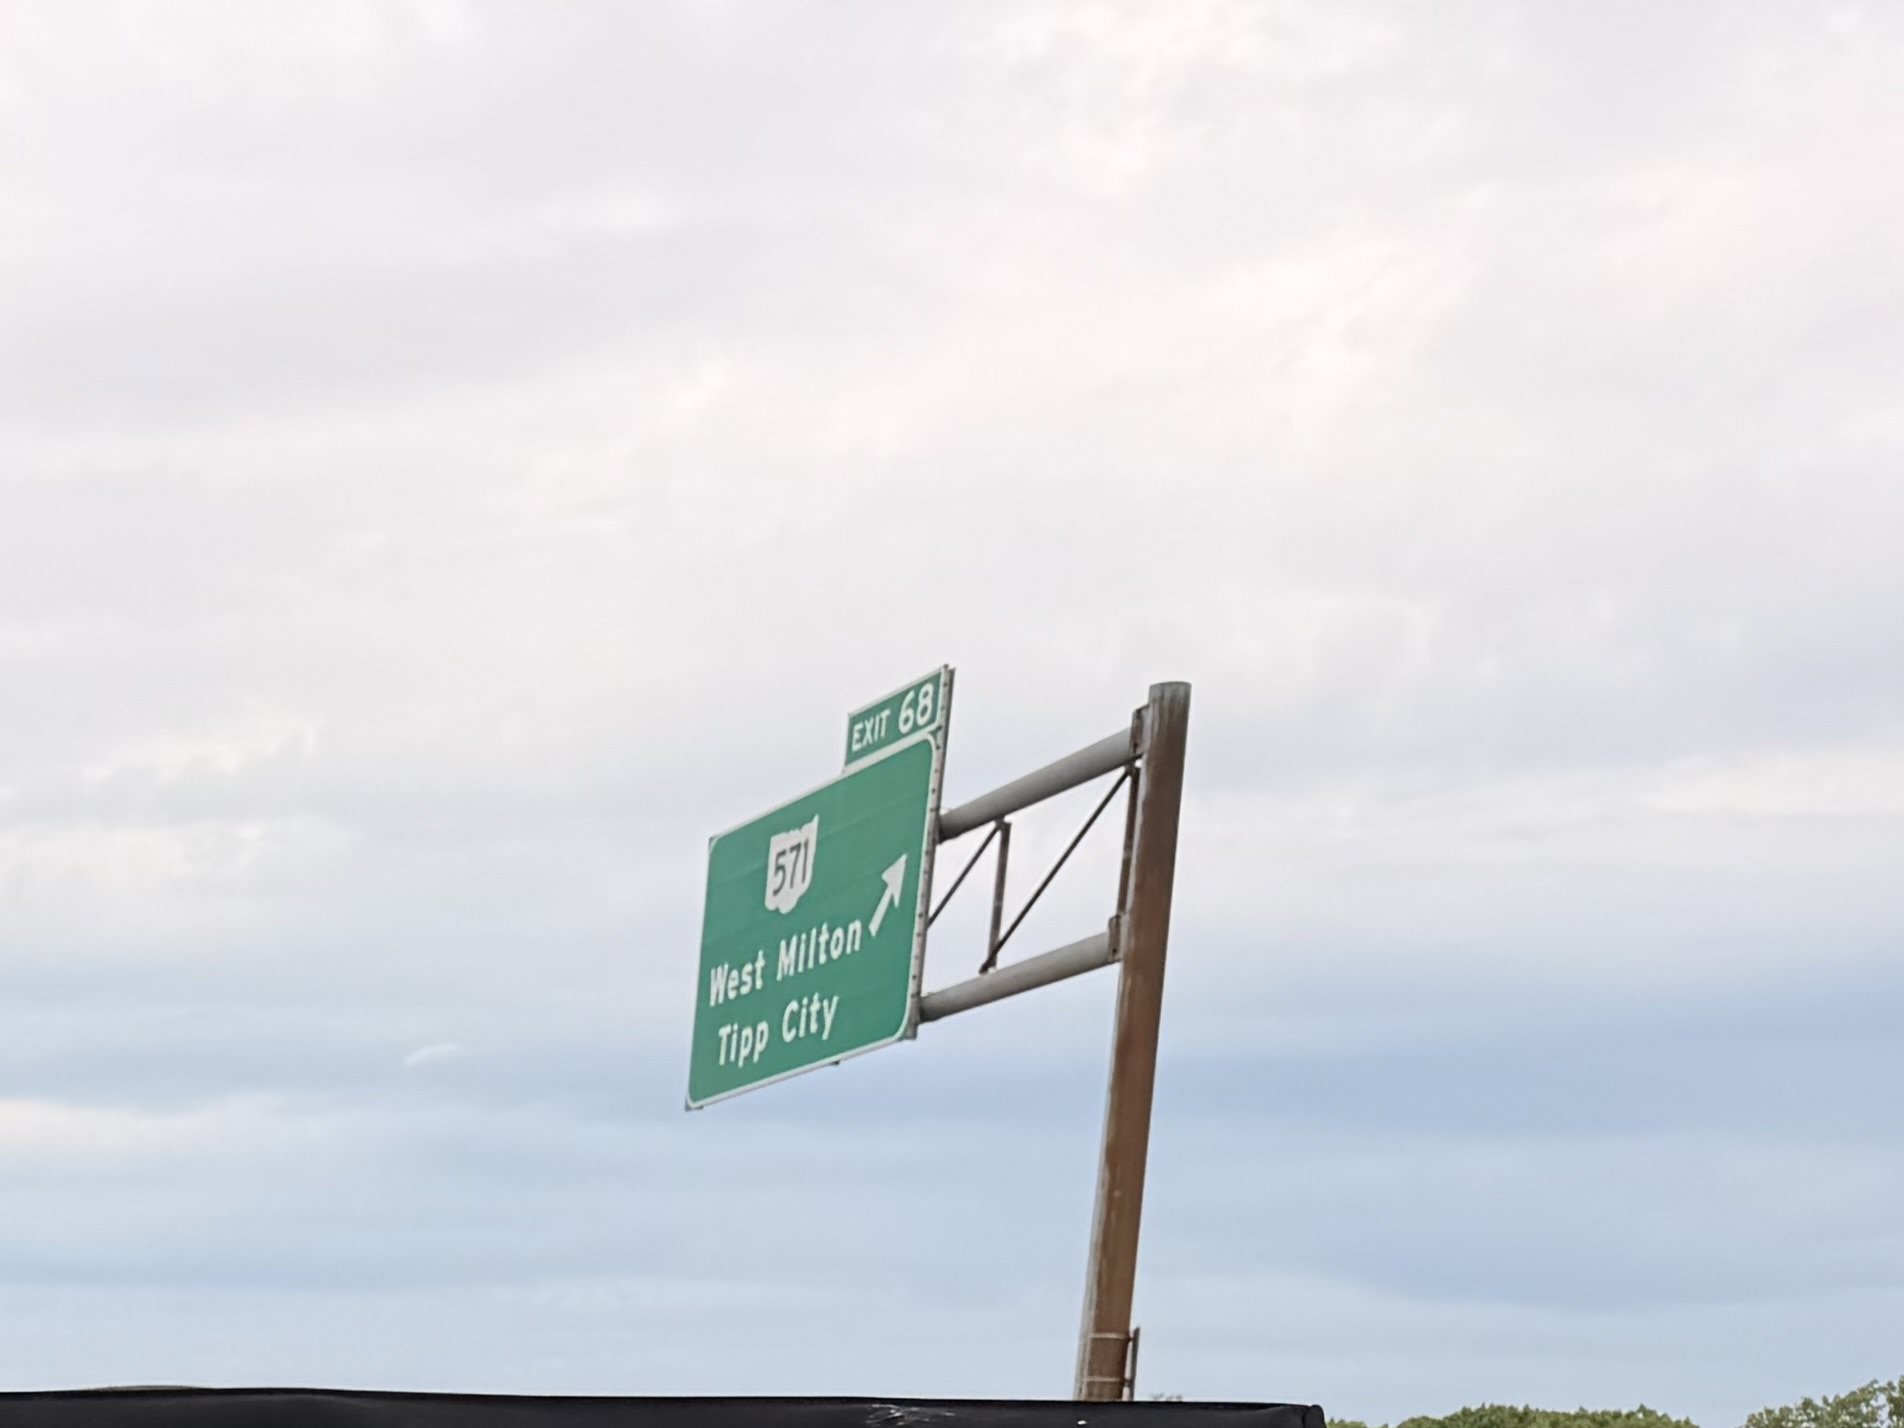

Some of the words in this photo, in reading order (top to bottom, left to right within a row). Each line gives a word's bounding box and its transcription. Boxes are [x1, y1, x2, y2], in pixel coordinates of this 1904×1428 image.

[851, 709, 891, 752] EXIT
[898, 683, 934, 734] 68
[773, 838, 809, 896] 571
[709, 950, 765, 1007] West
[776, 919, 862, 981] Milton
[718, 1021, 769, 1068] Tipp
[782, 992, 839, 1043] City
